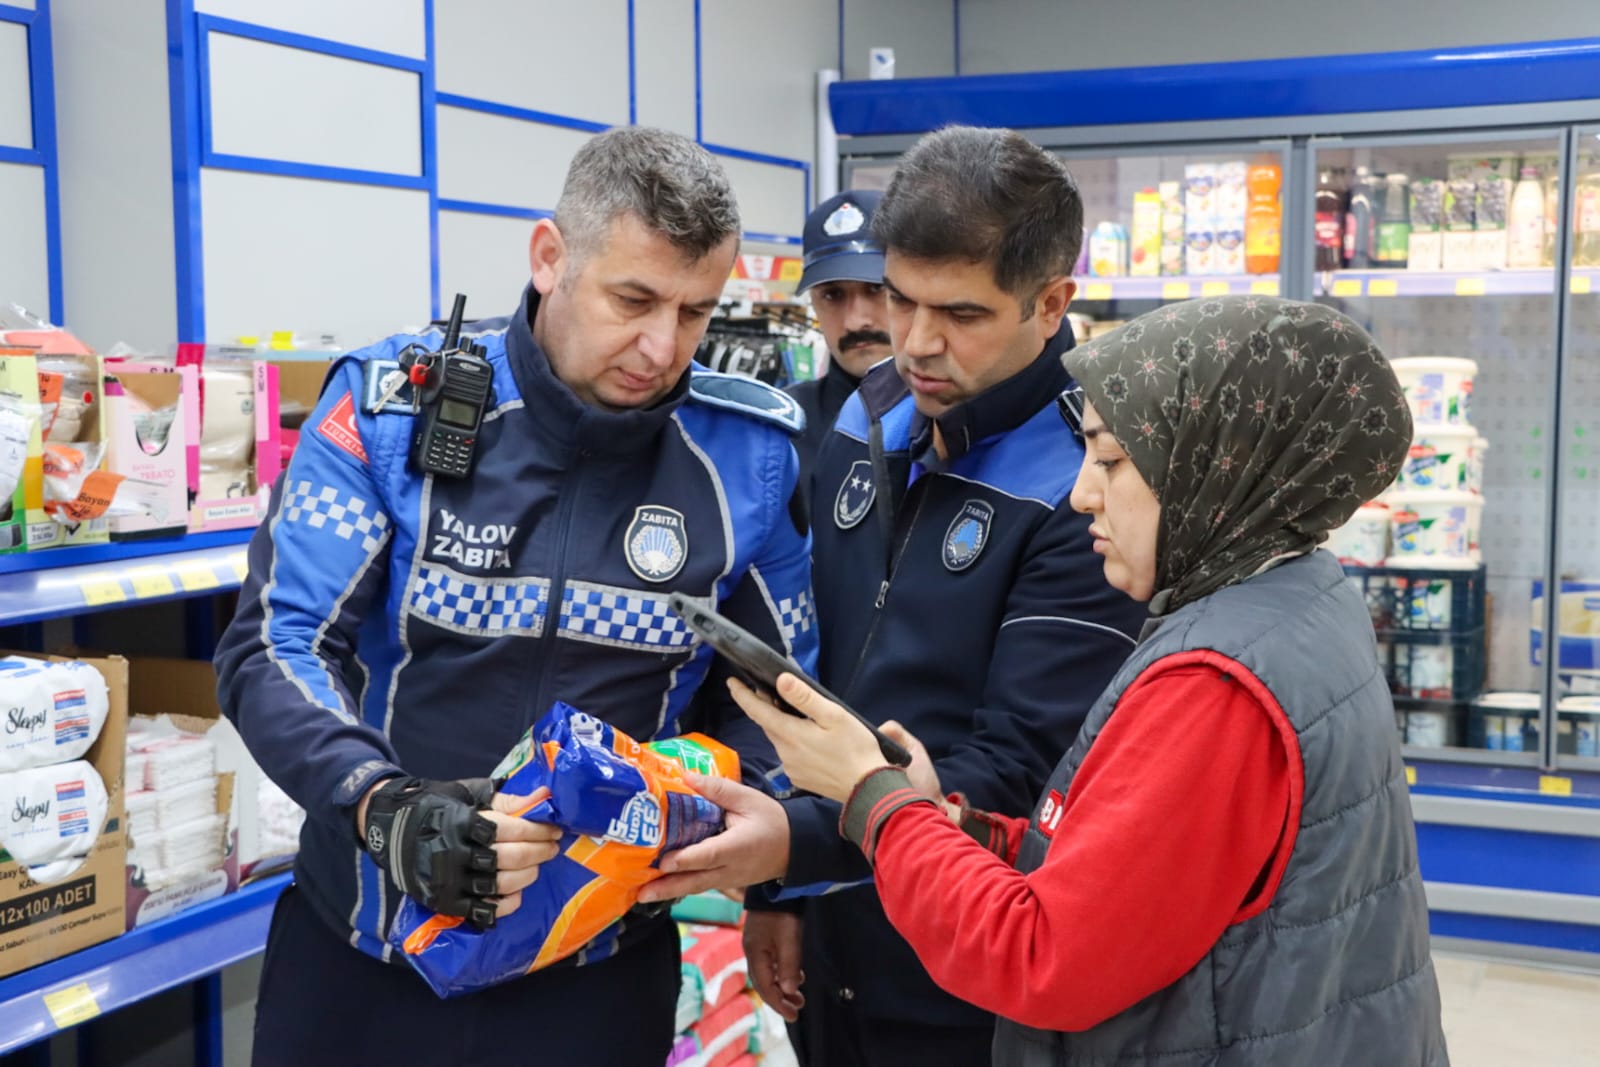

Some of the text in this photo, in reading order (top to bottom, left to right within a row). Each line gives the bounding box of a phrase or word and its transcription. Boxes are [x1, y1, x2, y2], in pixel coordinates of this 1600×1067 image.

[440, 509, 517, 545] YALOV
[641, 511, 679, 527] ZABITA
[342, 760, 395, 793] ZAB
[0, 882, 93, 926] 12x100 ADET
